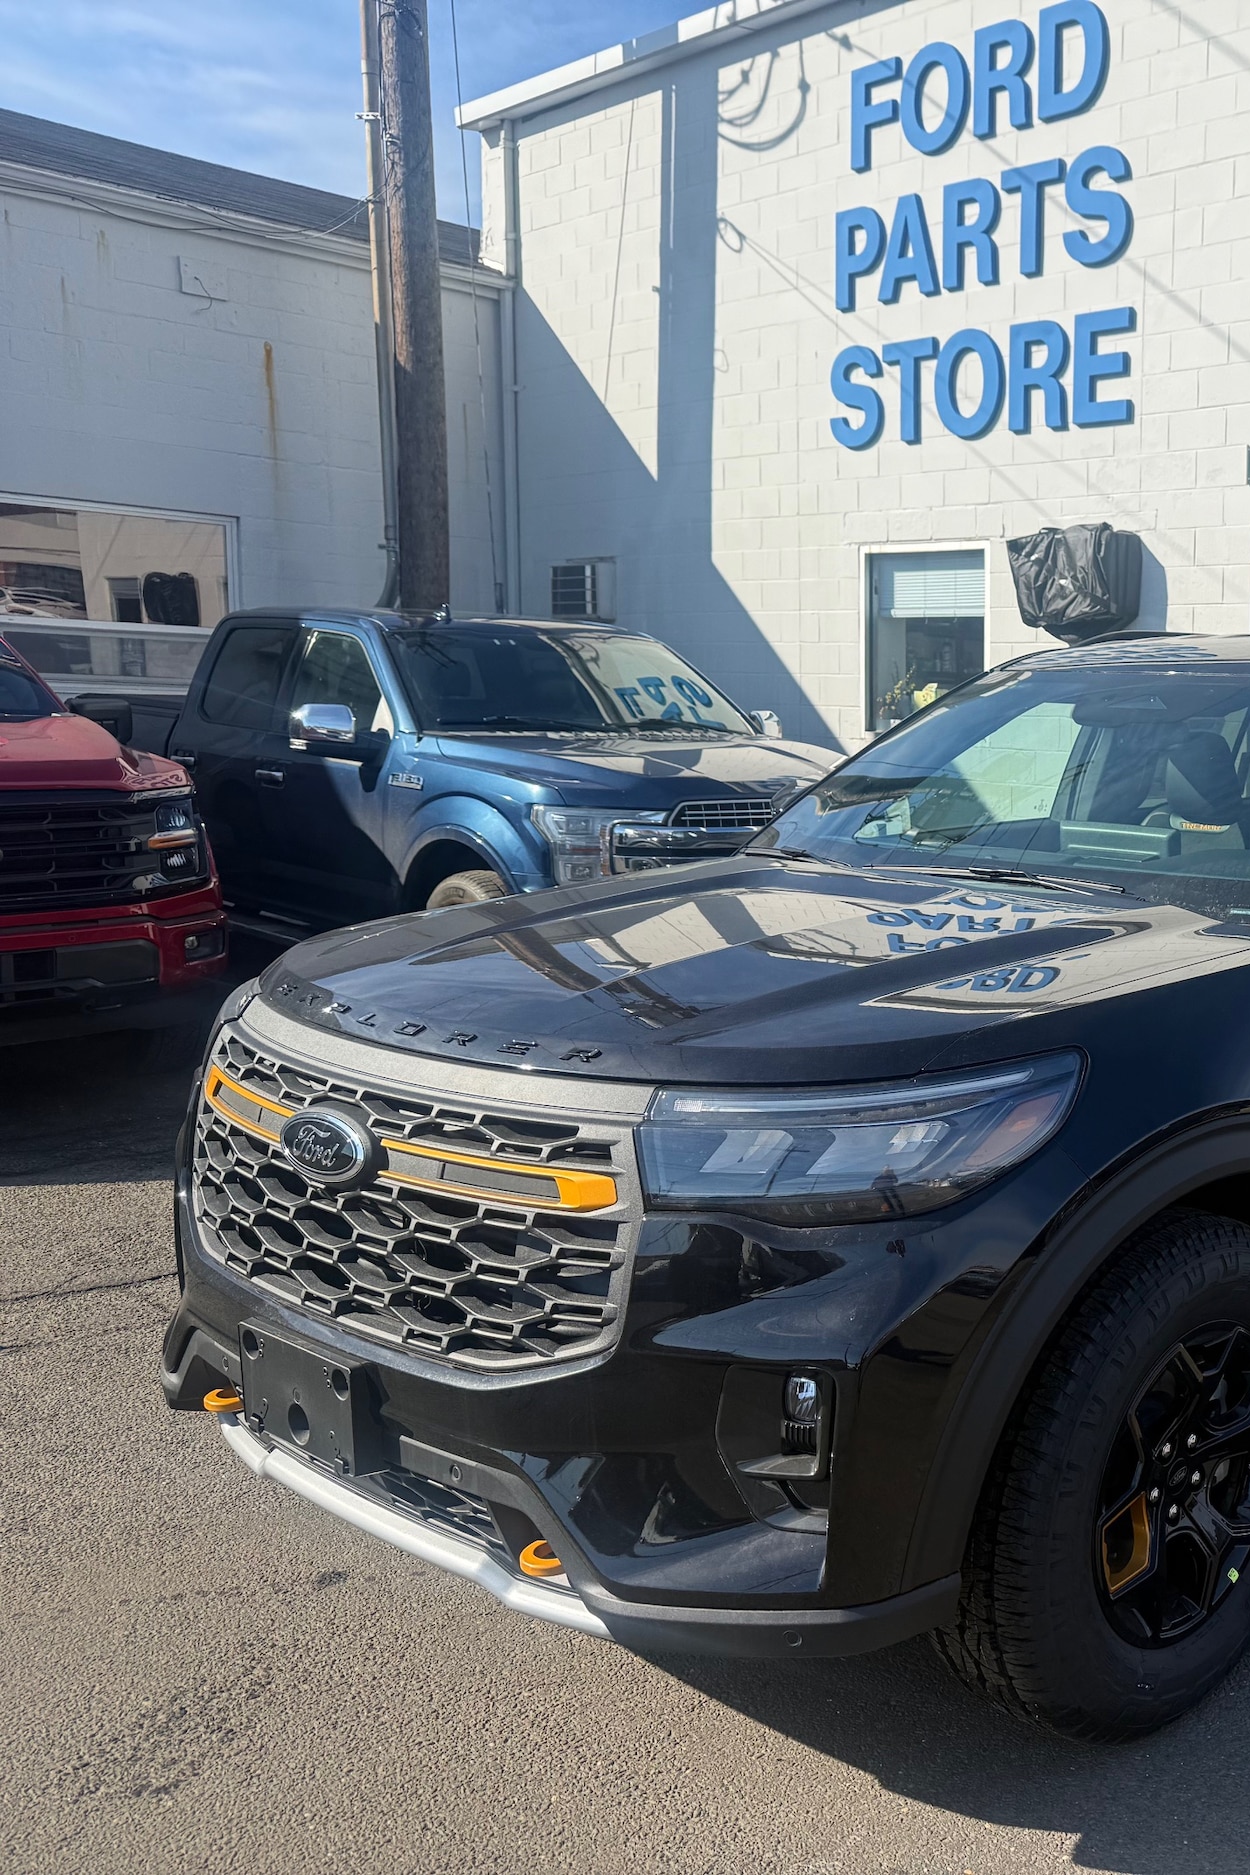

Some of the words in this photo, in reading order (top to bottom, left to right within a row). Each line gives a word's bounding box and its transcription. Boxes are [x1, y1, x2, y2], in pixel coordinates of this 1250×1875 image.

[851, 0, 1111, 174] FORD
[835, 145, 1134, 314] PARTS
[830, 306, 1137, 451] STORE
[293, 1123, 340, 1168] Ford
